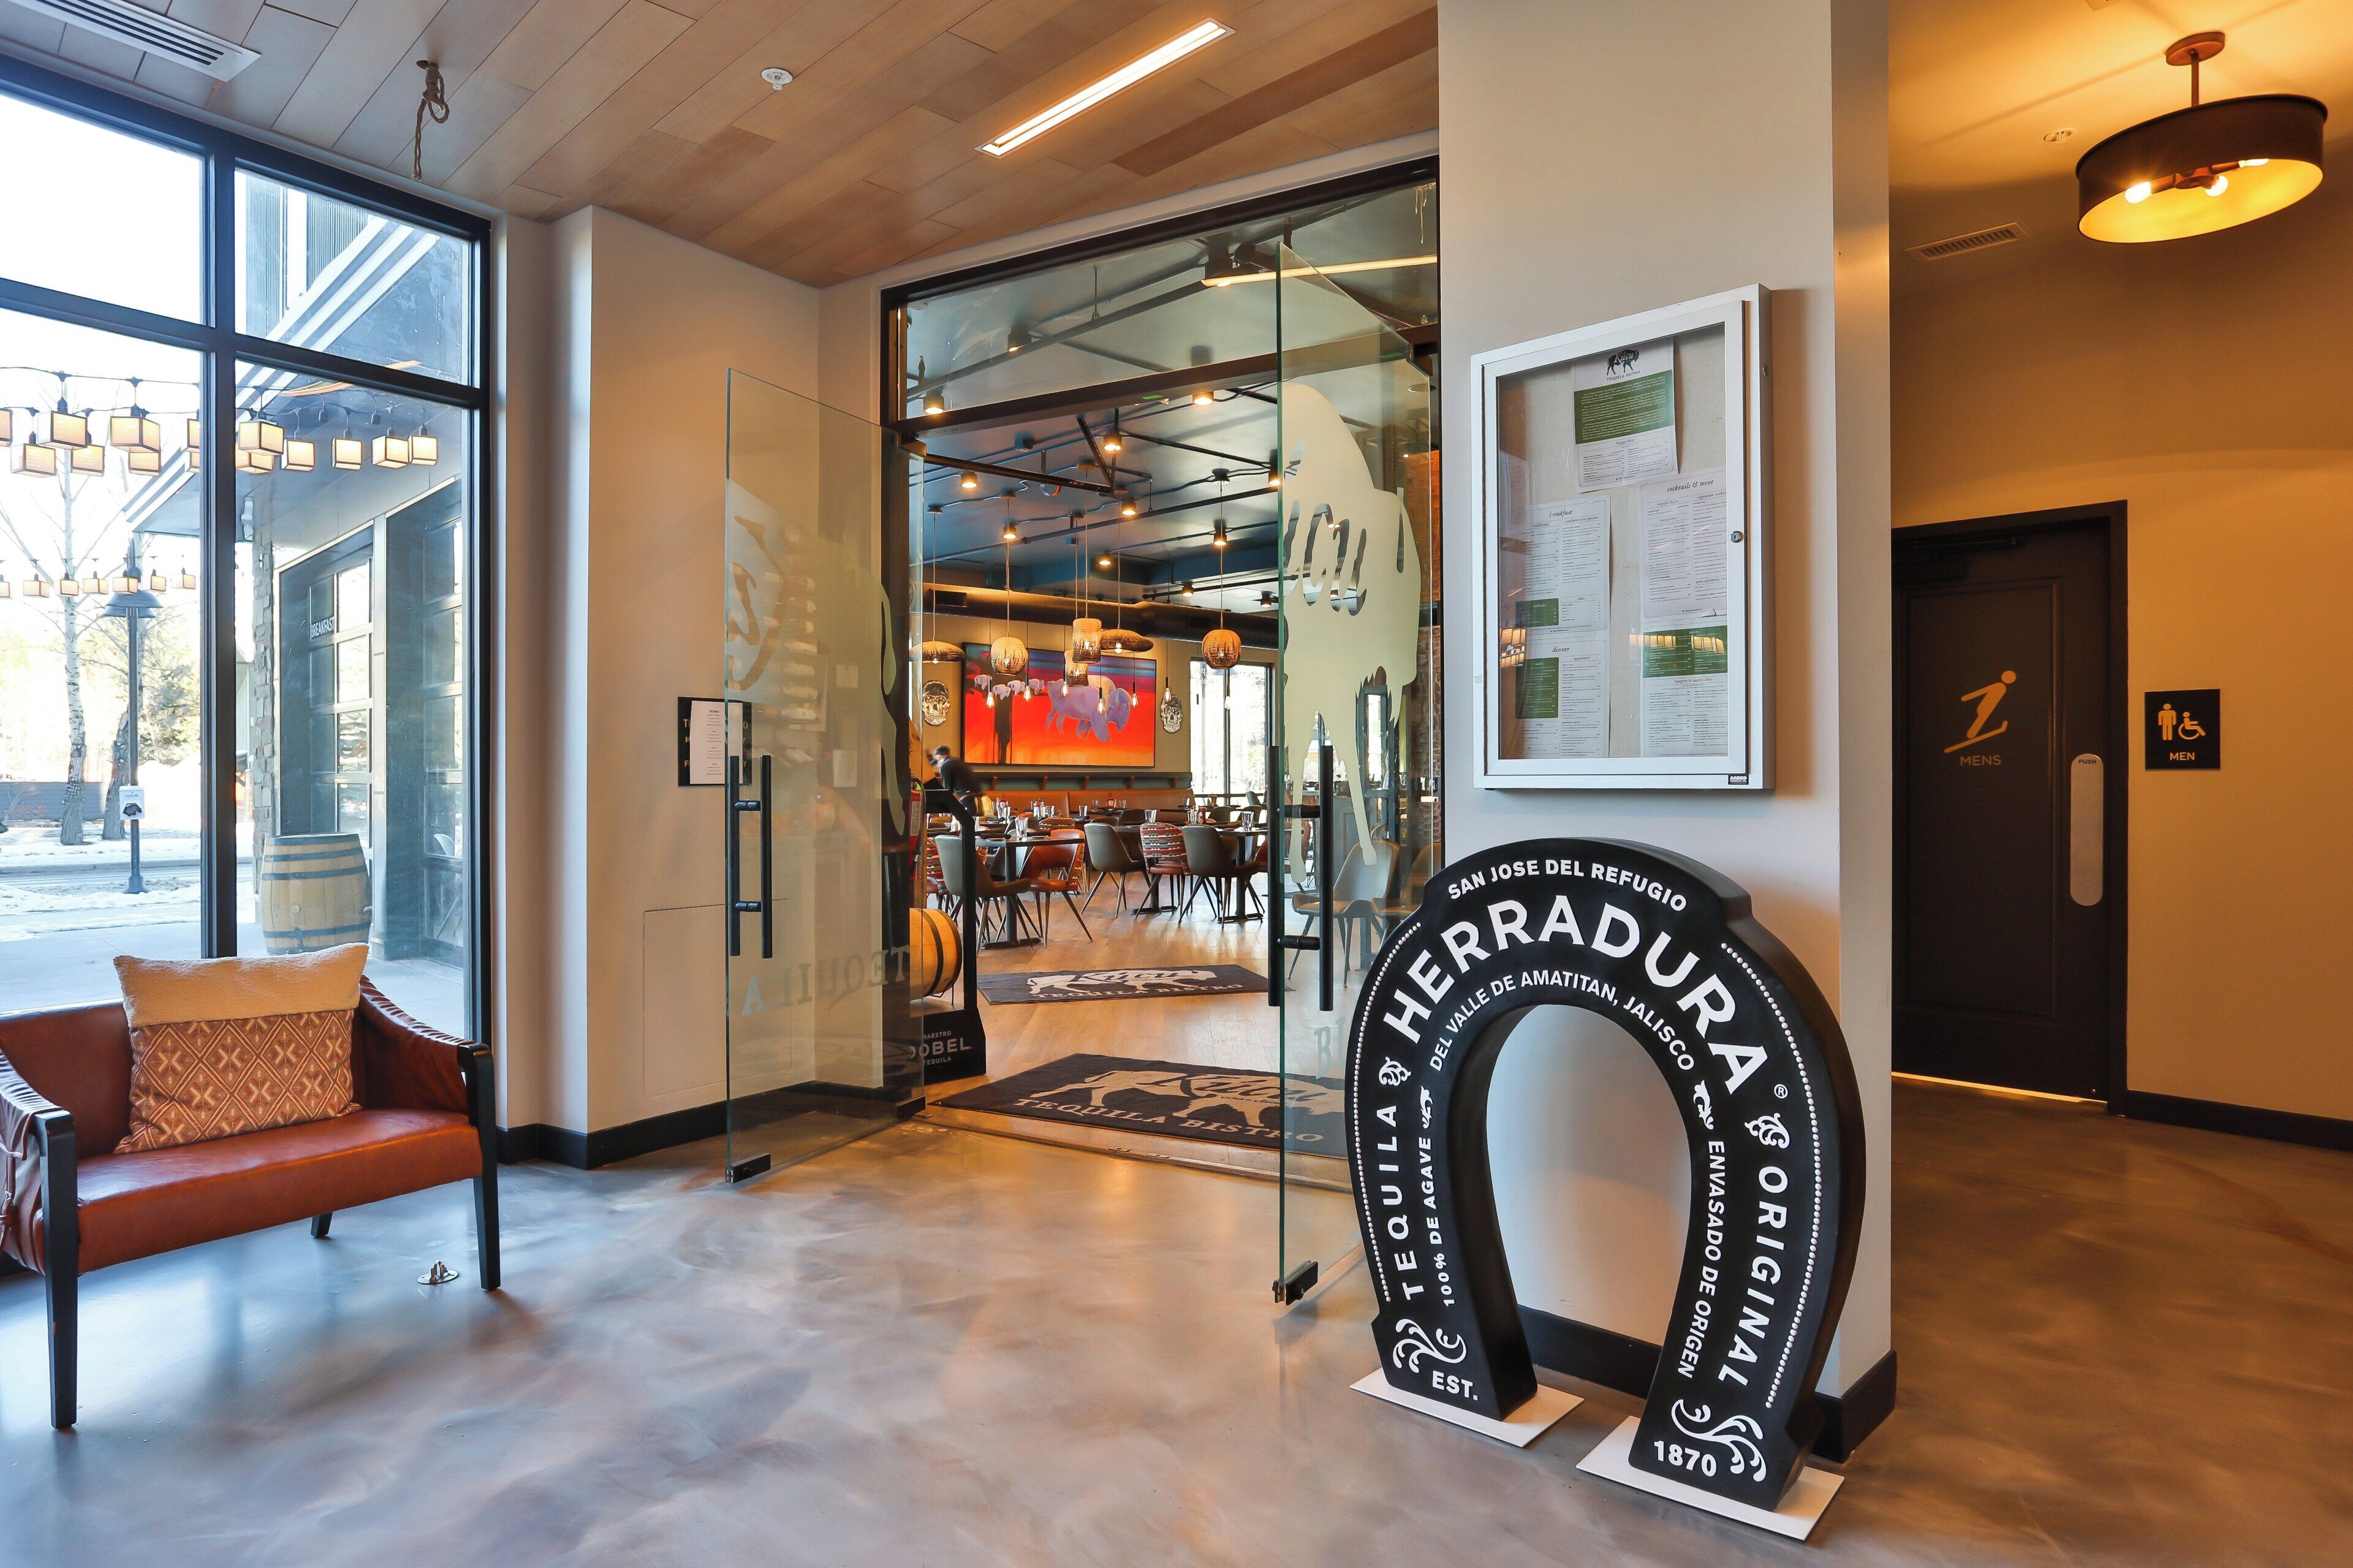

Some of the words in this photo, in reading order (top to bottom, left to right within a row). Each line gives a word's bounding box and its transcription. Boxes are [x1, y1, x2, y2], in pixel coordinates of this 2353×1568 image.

[1667, 482, 1691, 492] cocktails
[311, 616, 335, 638] BREAKFAST
[1960, 755, 2003, 766] MENS
[2170, 752, 2195, 760] MEN
[1448, 877, 1486, 900] SAN
[1490, 860, 1540, 882] JOSE
[1545, 859, 1584, 877] DEL
[1591, 863, 1686, 911] REFUGIO
[1383, 895, 1768, 1095] HERRADURA
[922, 1031, 952, 1040] MAESTRO
[1430, 1037, 1453, 1072] DEL
[1446, 988, 1490, 1033] VALLE
[1490, 975, 1517, 996] DE
[1521, 969, 1618, 1007] AMATITAN,
[1623, 996, 1694, 1070] JALISCO
[923, 1056, 952, 1066] TEQUILA
[1014, 1099, 1166, 1124] TEQUILA
[1179, 1119, 1324, 1142] BISTRO
[1419, 1137, 1436, 1210] AGAVE
[1376, 1105, 1425, 1300] TEQUILA
[1705, 1141, 1726, 1261] ENVASADO
[1426, 1217, 1442, 1244] DE
[1433, 1253, 1455, 1306] 100%
[1699, 1265, 1719, 1296] DE
[1718, 1166, 1788, 1386] ORIGINAL
[1677, 1300, 1711, 1379] ORIGEN
[1432, 1370, 1478, 1401] EST.
[1654, 1440, 1717, 1477] 1870
